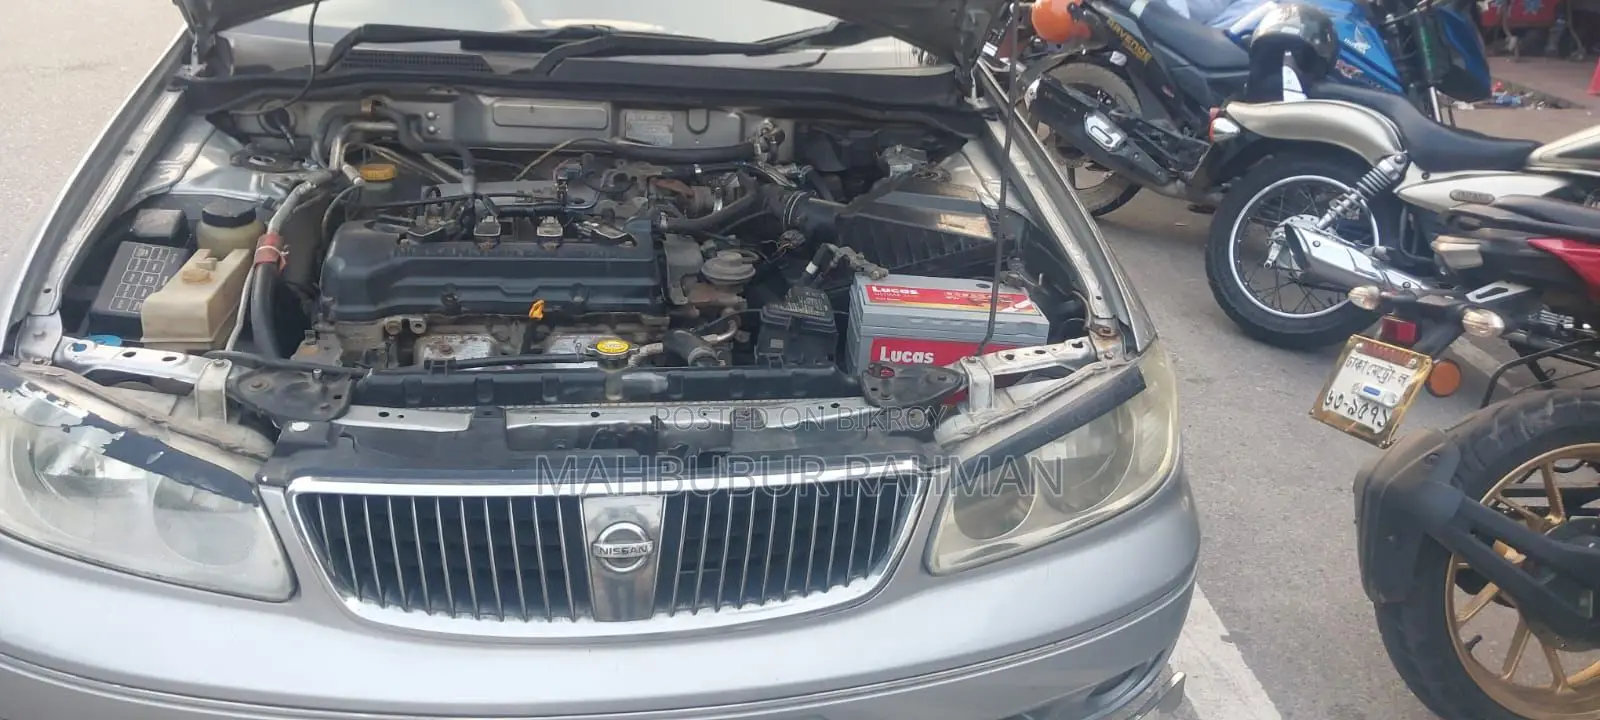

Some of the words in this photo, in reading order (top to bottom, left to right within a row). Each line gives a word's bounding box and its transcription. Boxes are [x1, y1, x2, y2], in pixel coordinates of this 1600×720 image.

[871, 285, 920, 296] Lucas
[879, 345, 935, 364] Lucas
[1345, 356, 1368, 373] ঢাকা
[599, 545, 648, 555] NISSAN
